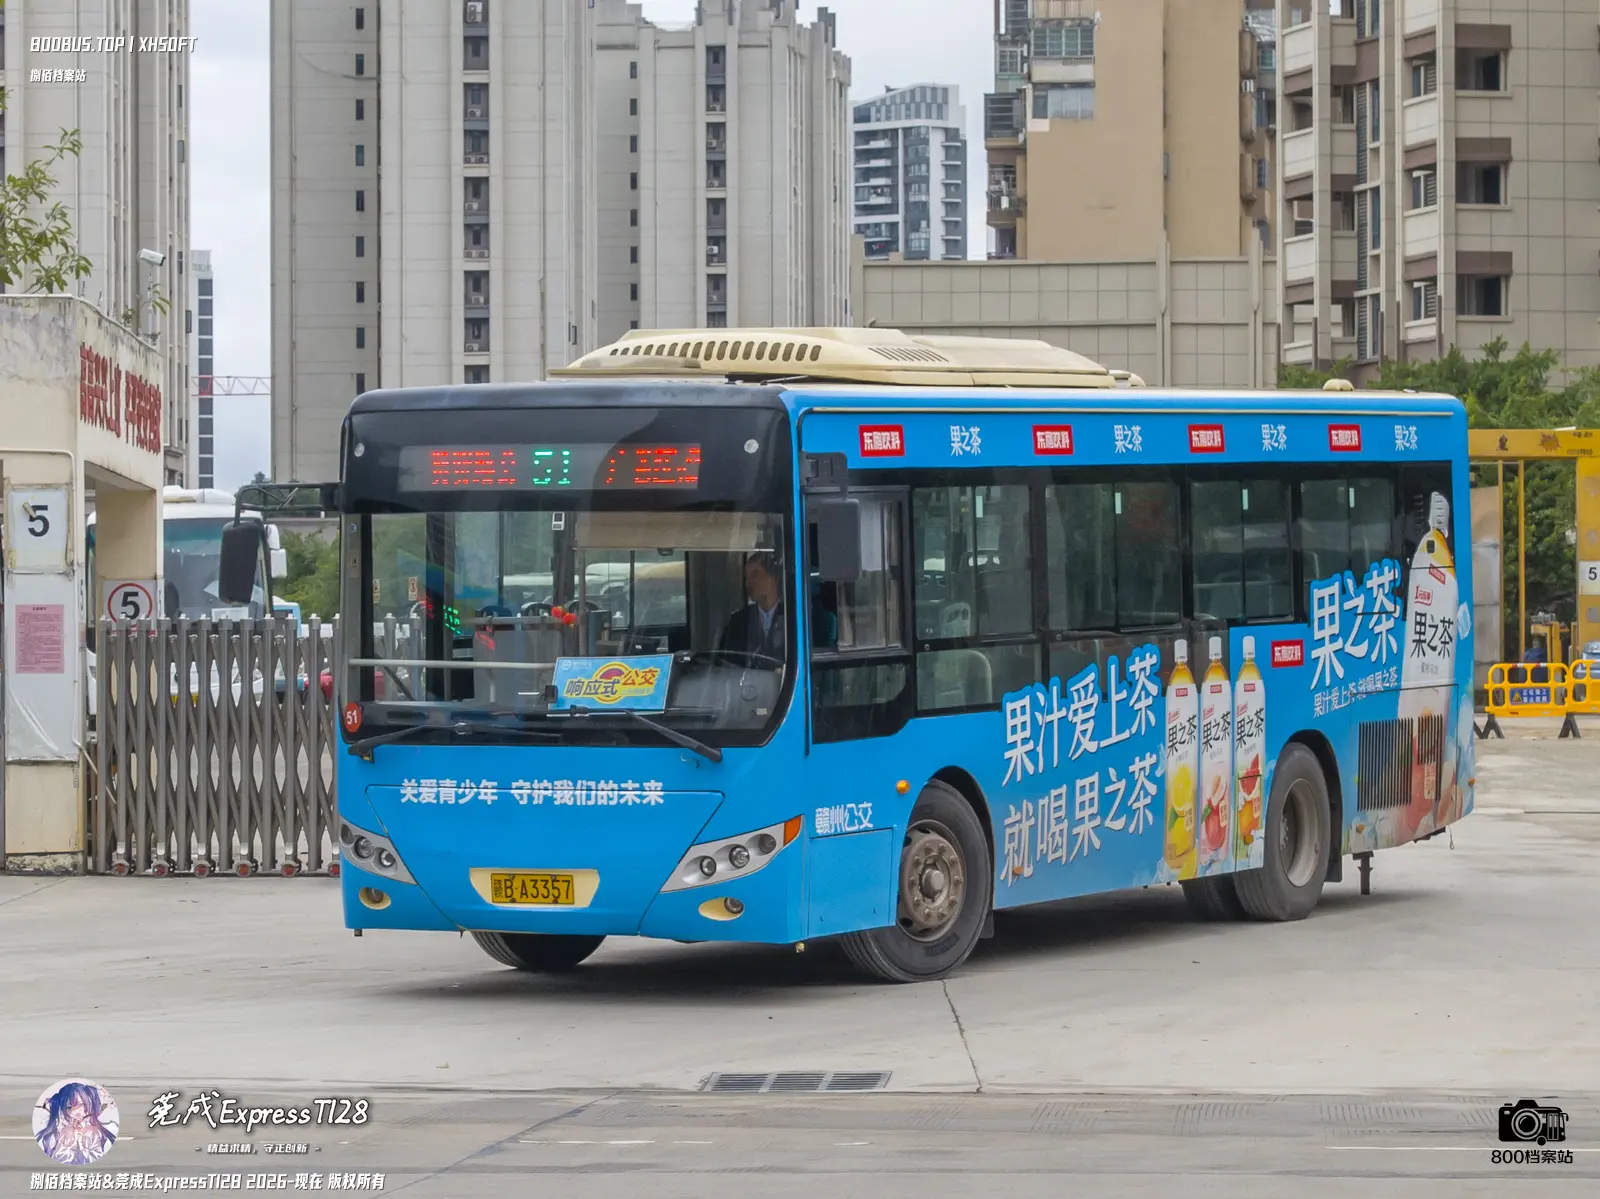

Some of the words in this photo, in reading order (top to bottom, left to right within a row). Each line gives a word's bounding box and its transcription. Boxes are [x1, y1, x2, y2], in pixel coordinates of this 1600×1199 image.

[950, 424, 982, 457] 果之茶
[1114, 424, 1143, 454] 果之茶
[1261, 424, 1287, 451] 果之茶
[1394, 424, 1419, 451] 果之茶
[533, 450, 571, 484] 51
[28, 504, 50, 537] 5
[1588, 567, 1597, 581] 5
[121, 591, 140, 620] 5
[1310, 565, 1400, 690] 果之茶
[1410, 610, 1454, 659] 果之茶
[565, 678, 620, 696] 响应式
[622, 668, 659, 686] 公交
[346, 709, 358, 725] 51
[1002, 652, 1158, 788] 果汁爱上茶
[1201, 711, 1231, 756] 果之茶
[1236, 707, 1264, 752] 果之茶
[1167, 714, 1197, 760] 果之茶
[400, 779, 498, 805] 关爱青少年
[510, 779, 665, 806] 守护我们的未来
[1000, 752, 1158, 888] 就喝果之茶
